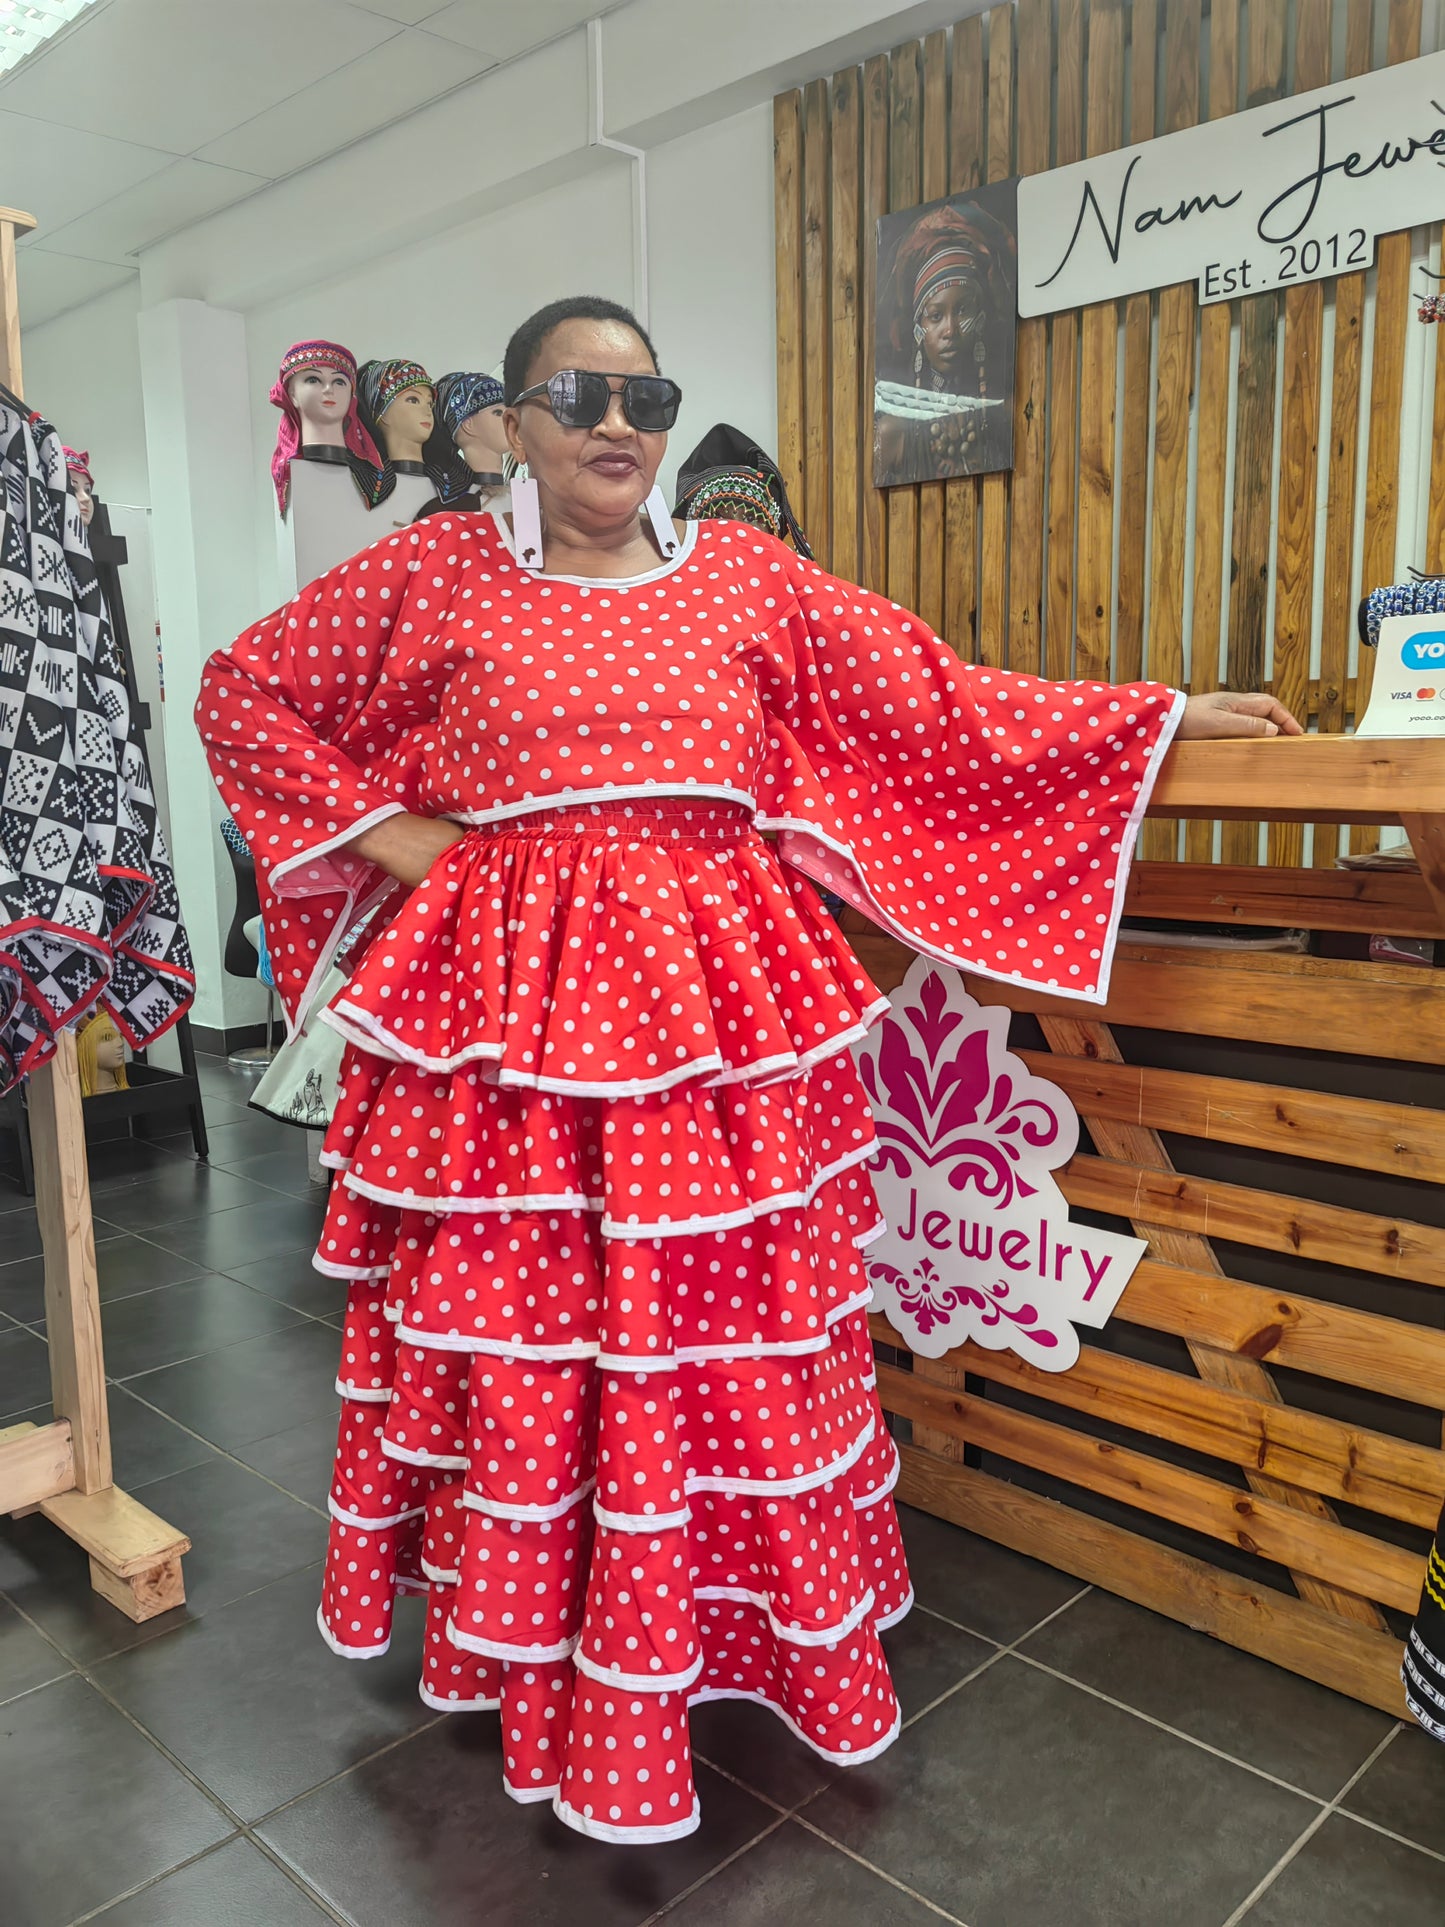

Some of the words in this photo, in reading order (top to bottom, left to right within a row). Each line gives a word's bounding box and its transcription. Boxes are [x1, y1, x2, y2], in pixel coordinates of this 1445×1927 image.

[1035, 155, 1243, 288] Nam
[1278, 228, 1368, 281] 2012
[1391, 691, 1412, 700] VISA
[897, 1188, 1113, 1302] Jewelry
